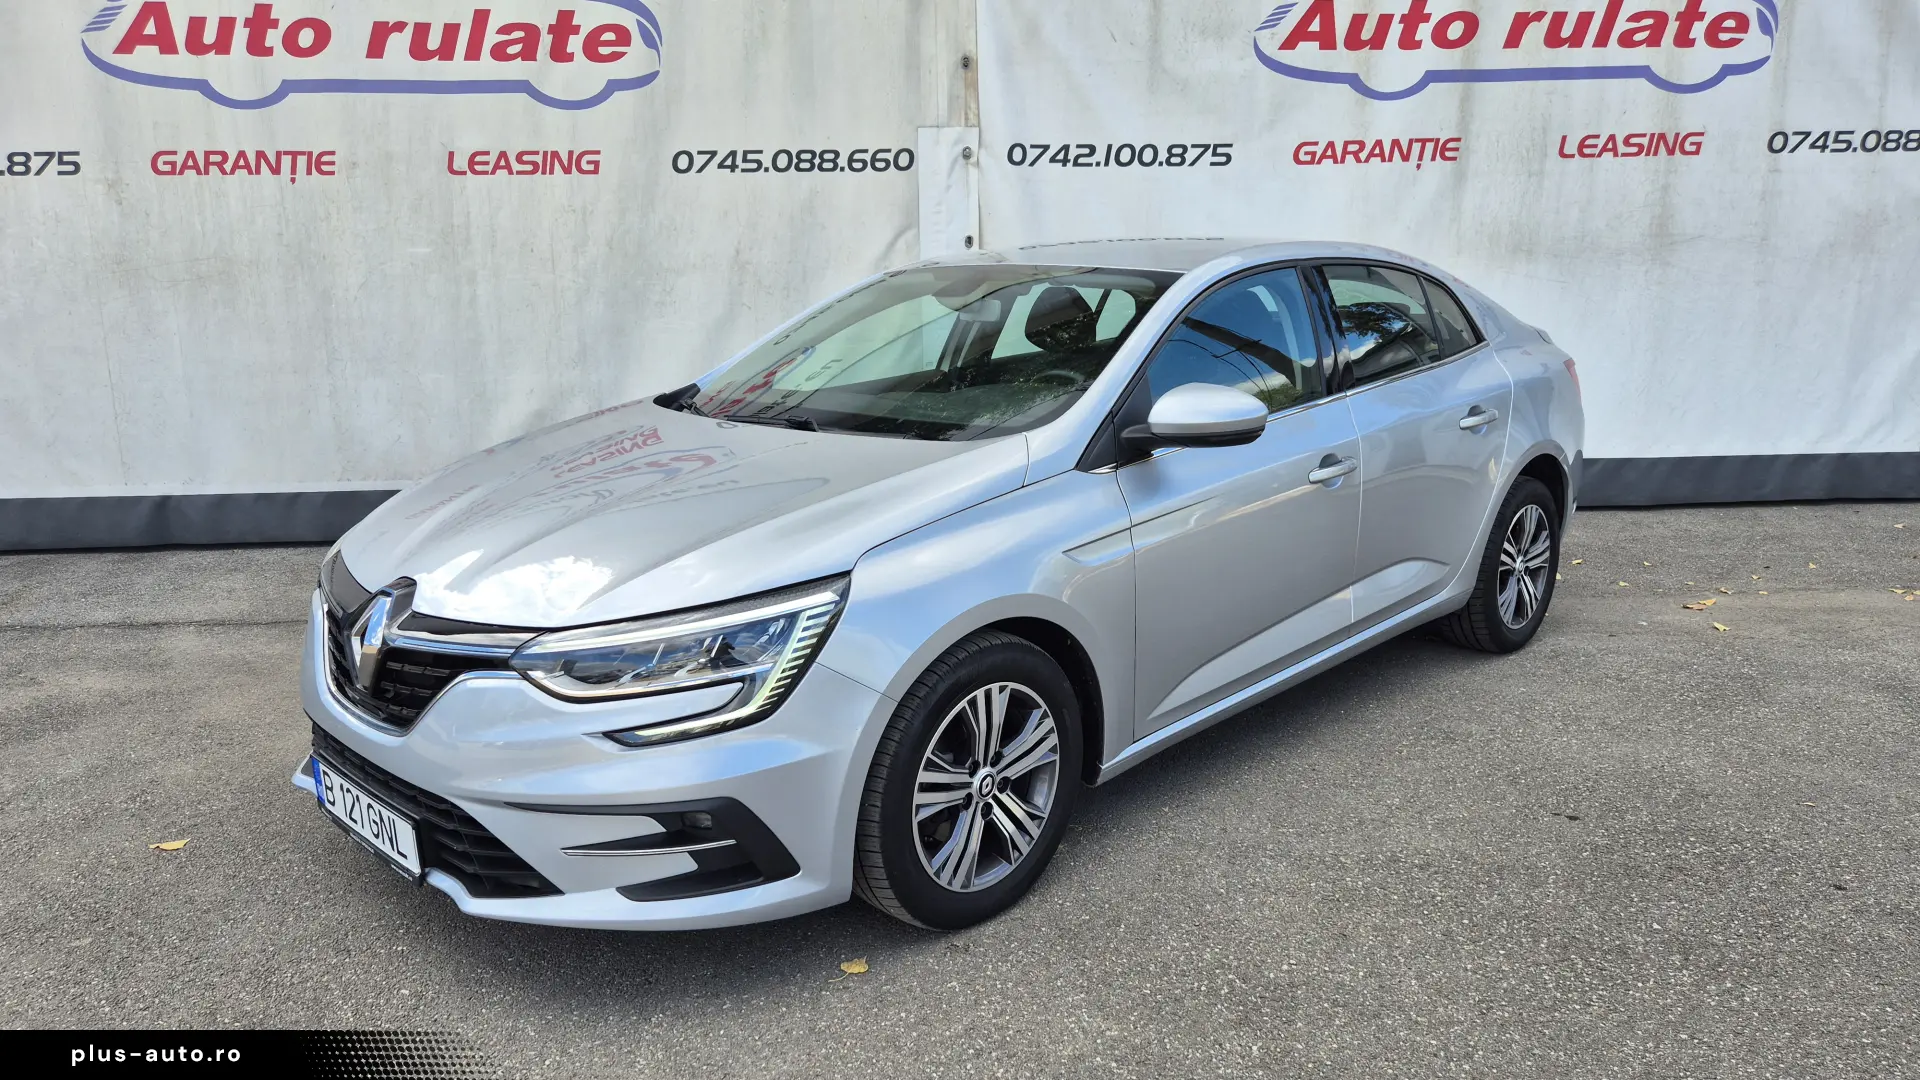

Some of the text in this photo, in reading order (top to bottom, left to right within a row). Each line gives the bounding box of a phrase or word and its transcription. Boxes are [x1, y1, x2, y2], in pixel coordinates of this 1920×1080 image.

[112, 1, 632, 63] Auto rulate
[1278, 0, 1750, 52] Auto rulate
[1006, 142, 1234, 168] 0742.100.875
[1292, 137, 1462, 170] GARANȚIE
[1558, 132, 1705, 159] LEASING
[1766, 129, 1920, 154] 0745.088
[150, 150, 336, 184] GARANȚIE
[447, 150, 601, 176] LEASING
[671, 147, 915, 174] 0745.088.660
[321, 768, 336, 807] B
[339, 782, 365, 830] 121
[366, 801, 409, 861] GNL
